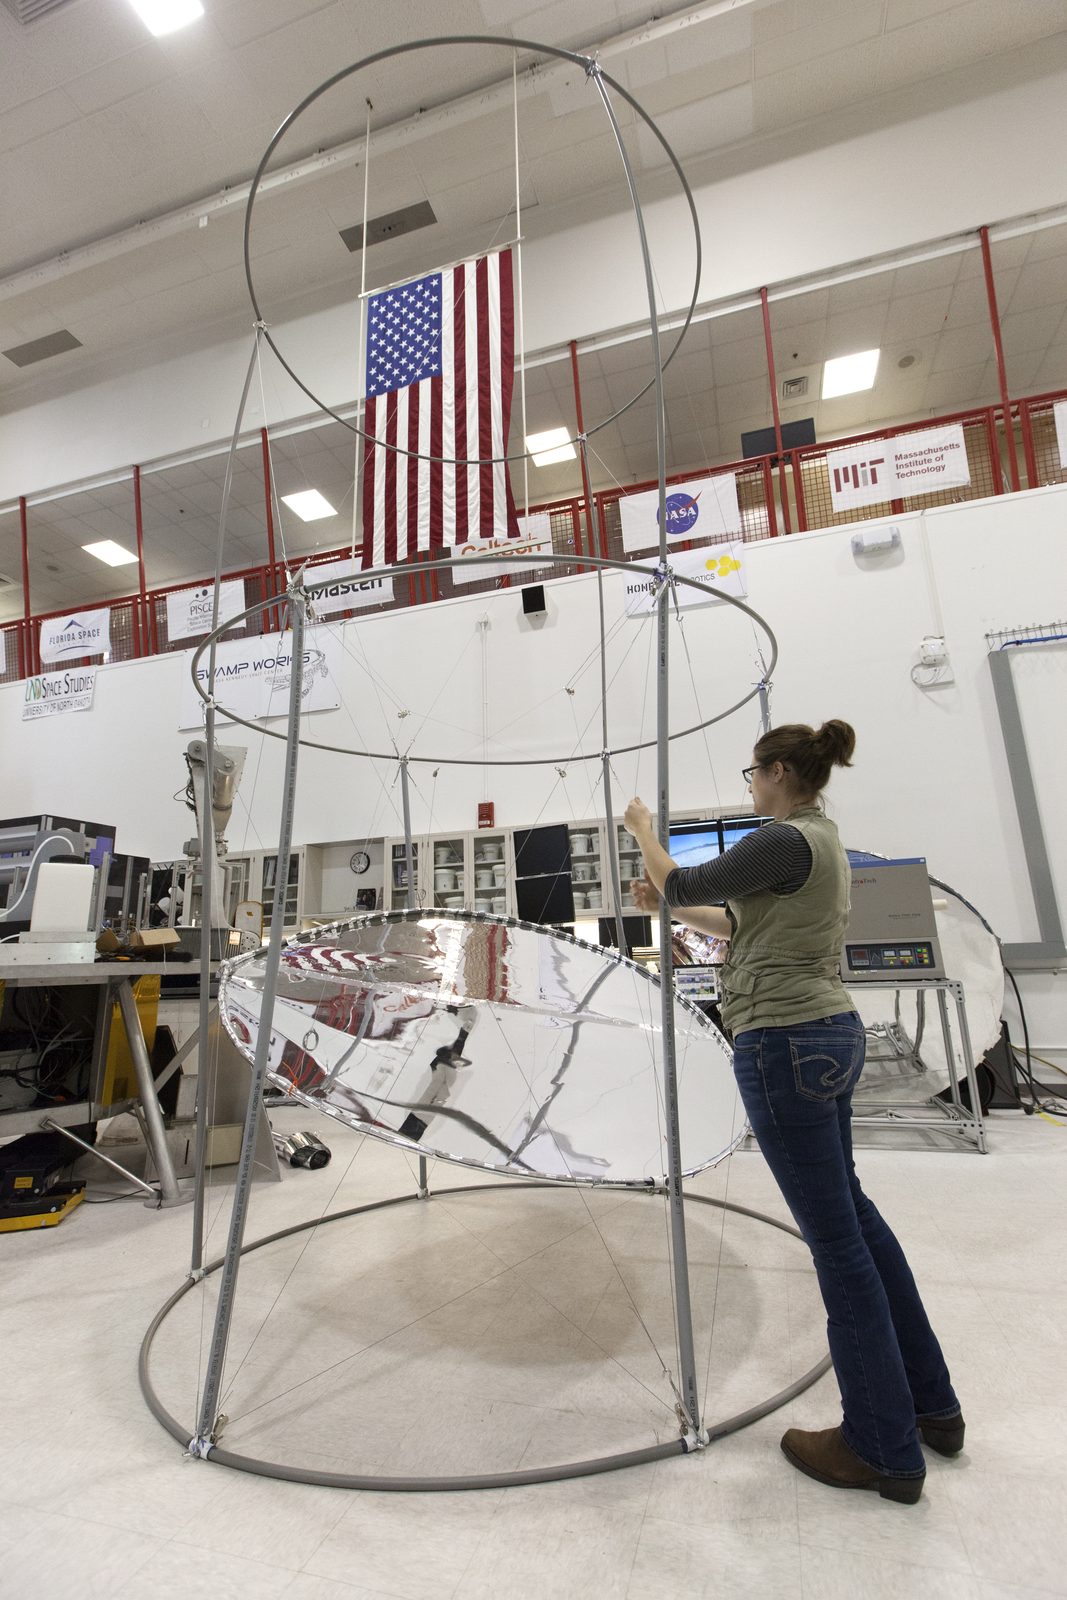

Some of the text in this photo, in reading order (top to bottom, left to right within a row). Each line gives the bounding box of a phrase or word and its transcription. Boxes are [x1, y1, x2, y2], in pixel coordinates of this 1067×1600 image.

[894, 442, 960, 462] Massachusetts
[895, 454, 945, 470] Institute of
[895, 463, 946, 480] Technology
[664, 506, 697, 521] ASA
[189, 602, 214, 616] PISCE
[49, 632, 76, 645] FLORIDA
[77, 628, 101, 640] SPACE
